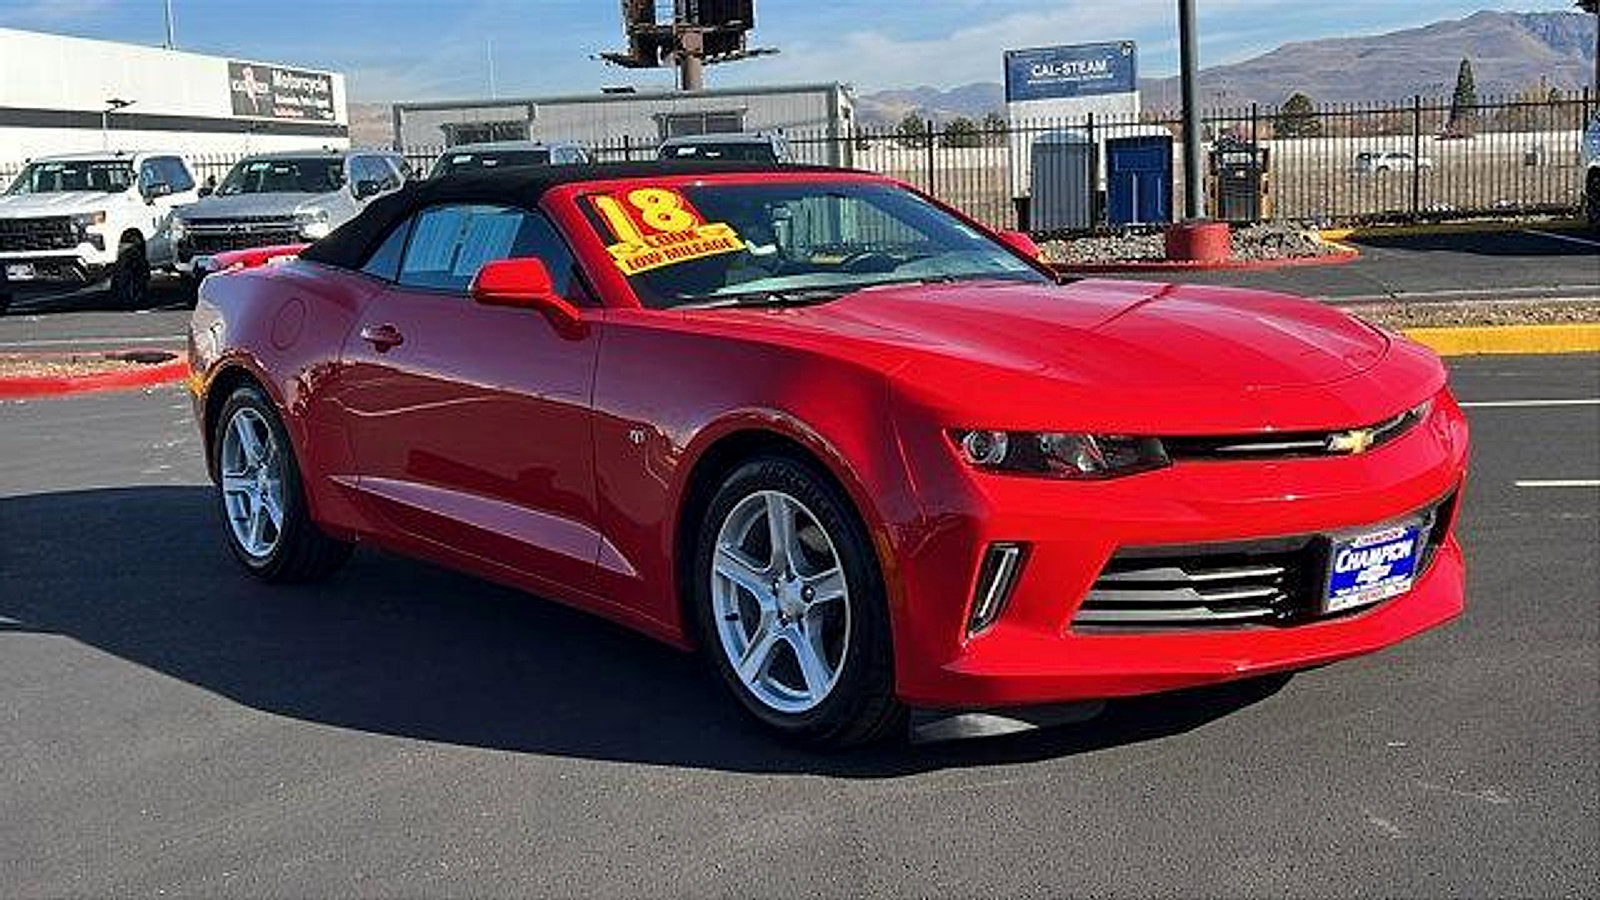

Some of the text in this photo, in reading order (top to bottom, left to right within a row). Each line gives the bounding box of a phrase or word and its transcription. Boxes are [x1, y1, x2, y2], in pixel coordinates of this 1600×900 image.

[271, 69, 329, 95] Motorcycle
[1031, 59, 1108, 77] CAL-STEAM
[595, 187, 696, 245] 18
[625, 237, 733, 271] LOW MILEAGE
[1335, 539, 1414, 574] CHAMPION
